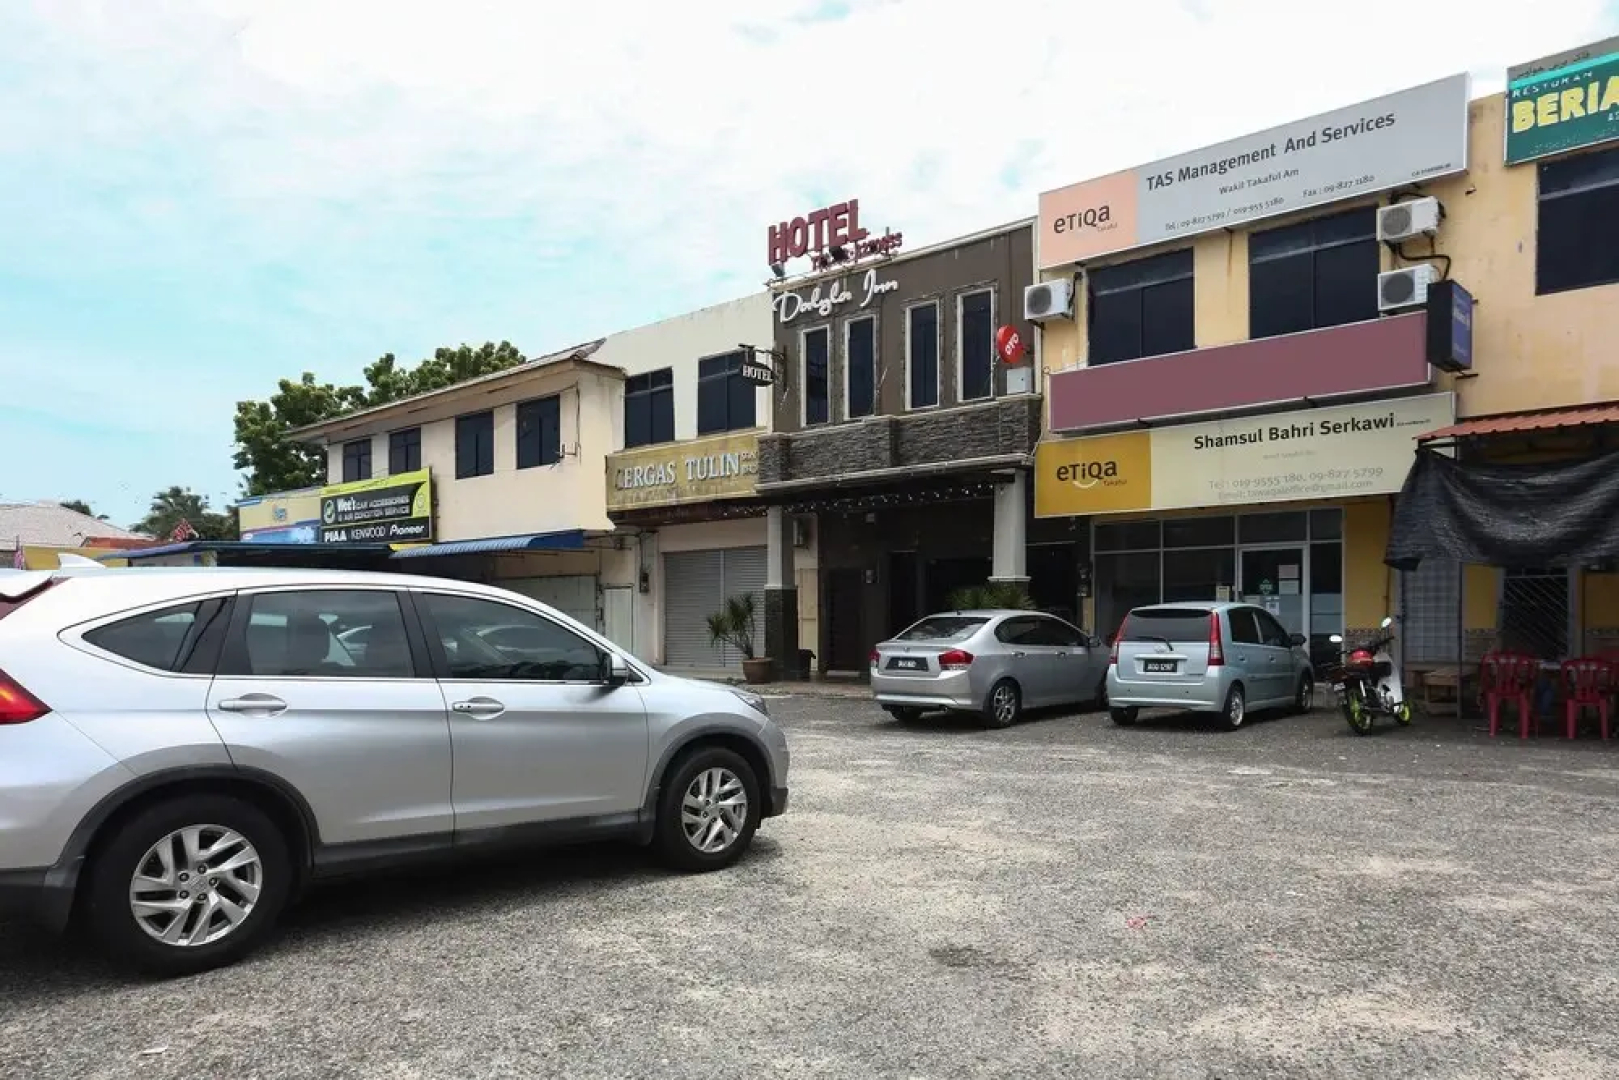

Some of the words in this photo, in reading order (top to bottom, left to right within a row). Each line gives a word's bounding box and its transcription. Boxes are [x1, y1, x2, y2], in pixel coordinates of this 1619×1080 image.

[1146, 172, 1174, 191] TAS
[1178, 144, 1276, 182] Management
[1284, 131, 1316, 153] And
[1321, 112, 1395, 143] Services
[1218, 180, 1244, 195] Wakil
[1247, 171, 1282, 187] Takaful
[1283, 168, 1299, 179] Am
[1303, 187, 1317, 198] Fax
[768, 199, 870, 266] HOTEL
[860, 268, 898, 307] Inn
[742, 364, 773, 382] HOTEL
[1194, 428, 1263, 450] Shamsul
[1269, 422, 1314, 441] Bahri
[1320, 412, 1395, 435] Serkawi
[685, 452, 739, 481] TULIN
[351, 526, 385, 539] KENWOOD
[390, 524, 425, 537] Pioneer
